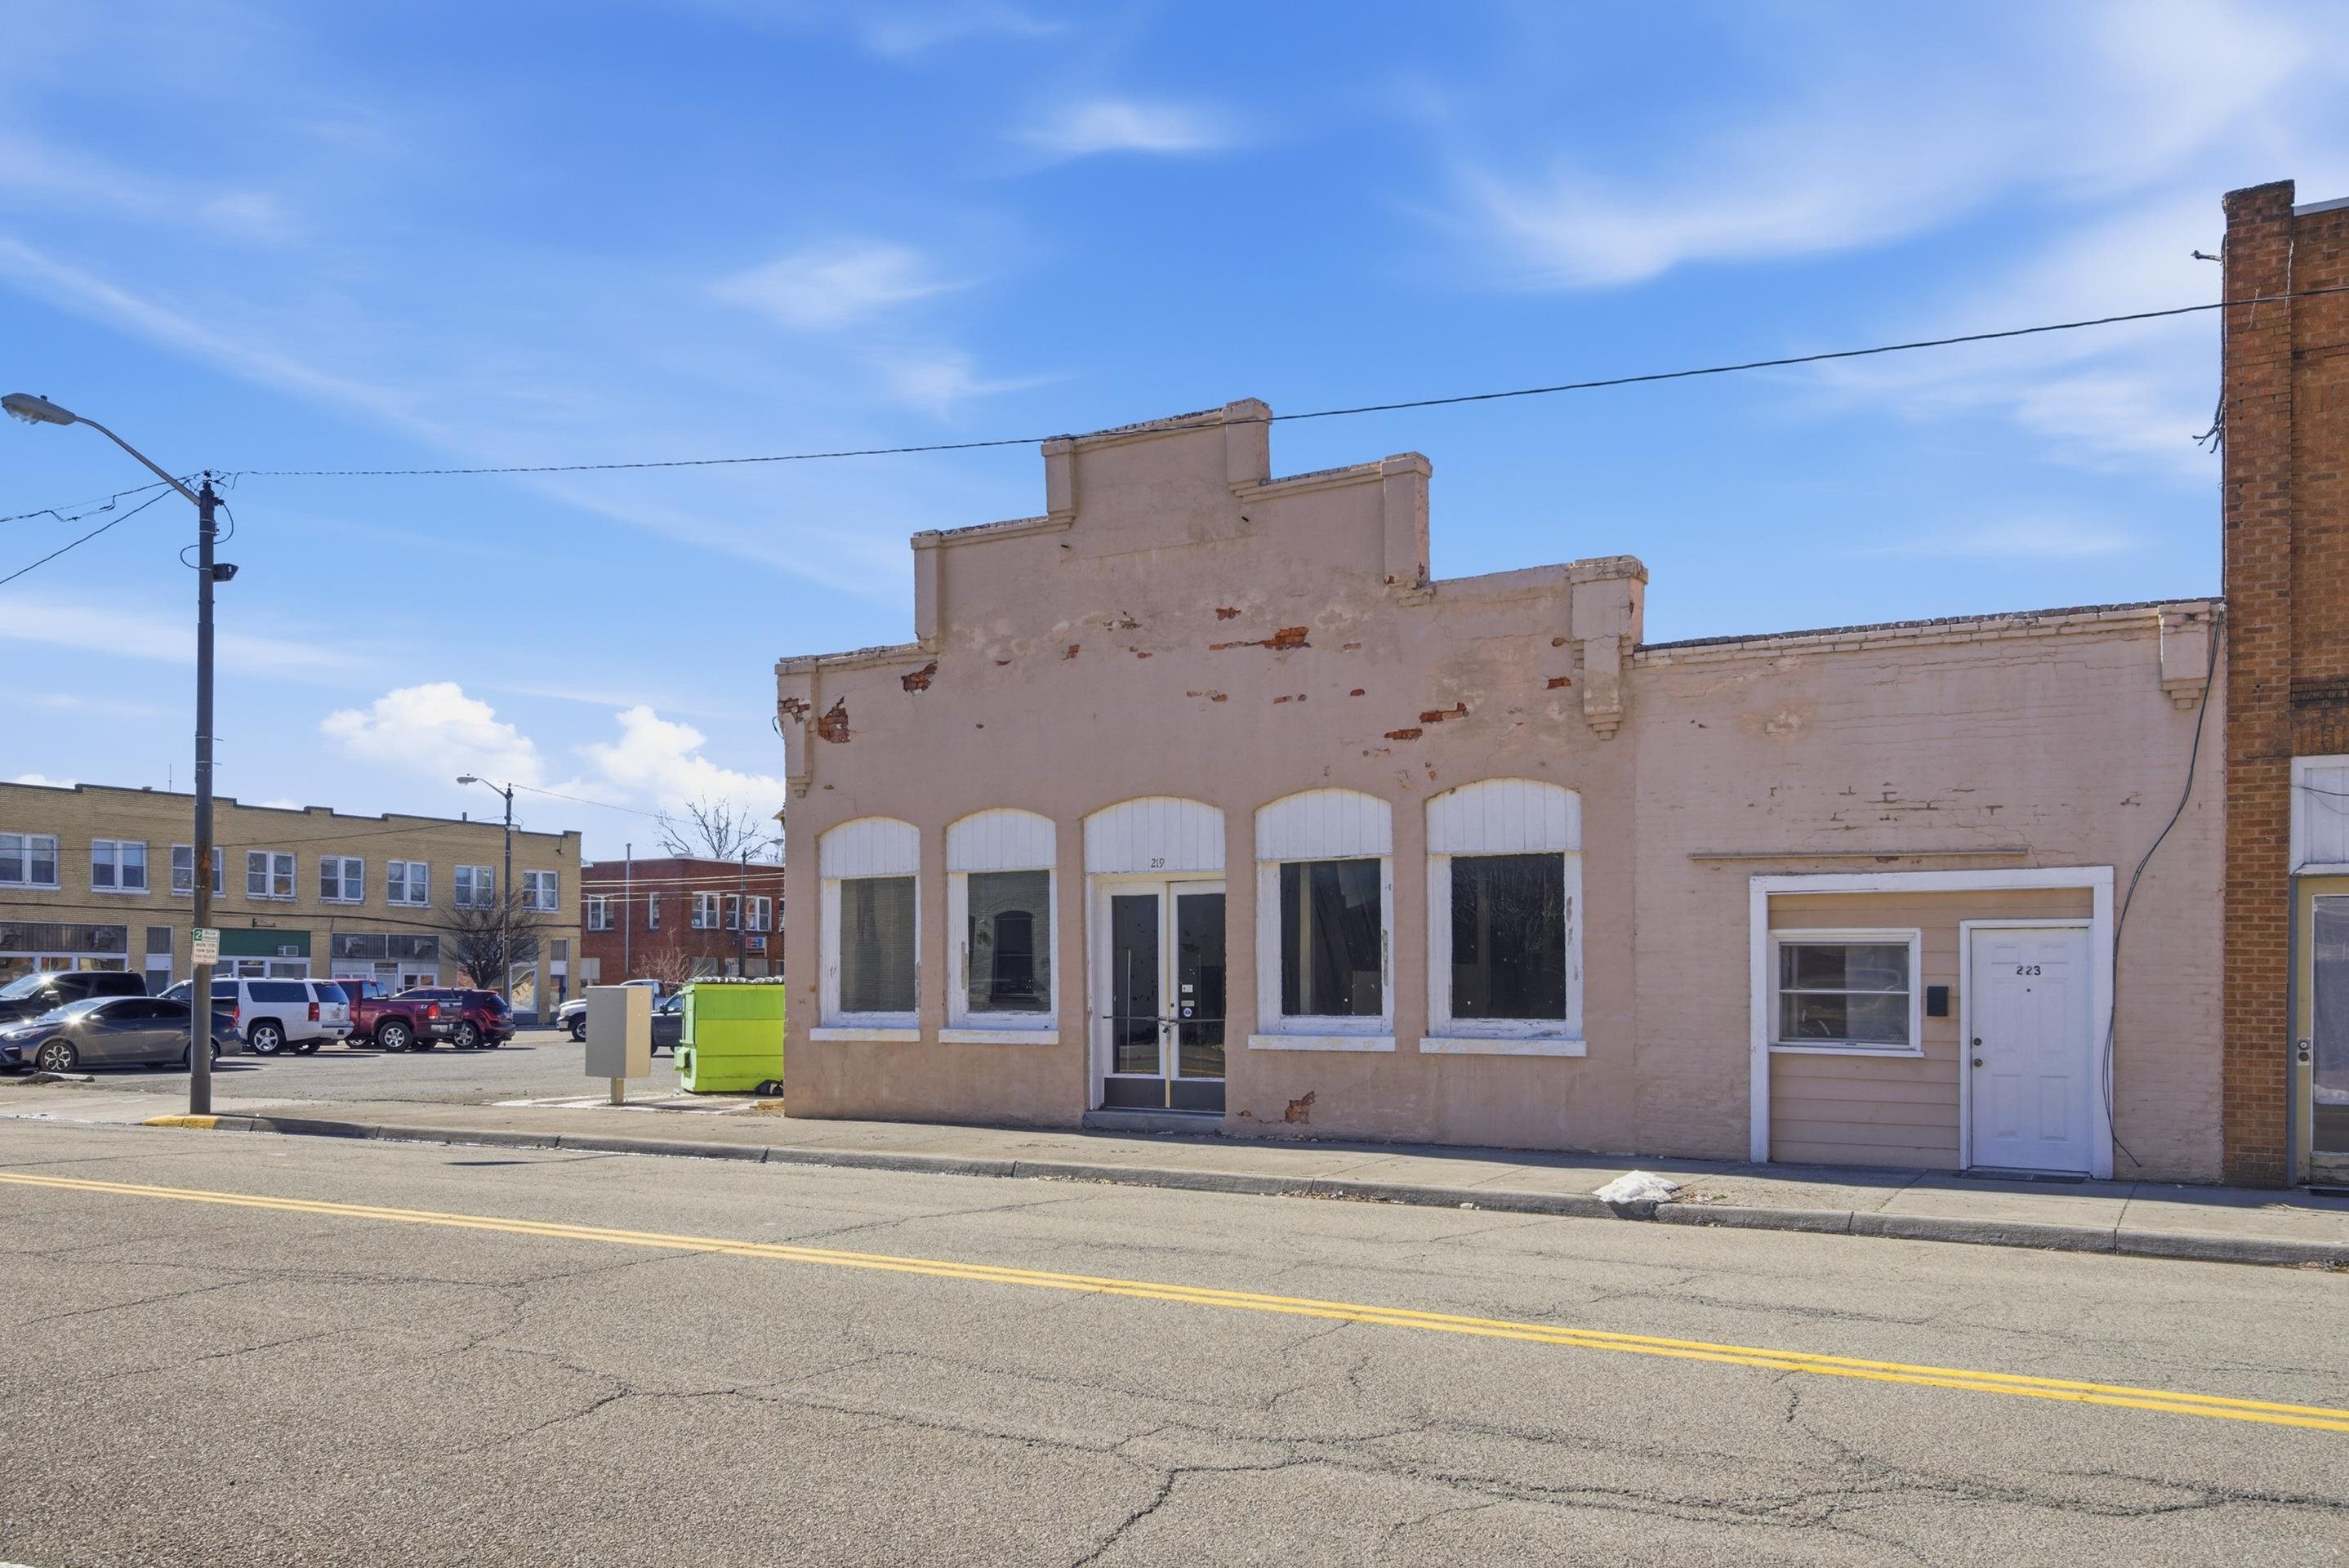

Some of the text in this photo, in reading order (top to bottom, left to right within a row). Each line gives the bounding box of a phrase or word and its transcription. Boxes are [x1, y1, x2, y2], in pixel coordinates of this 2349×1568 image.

[1151, 858, 1164, 868] 219
[195, 930, 201, 939] 2
[2017, 965, 2041, 975] 223
